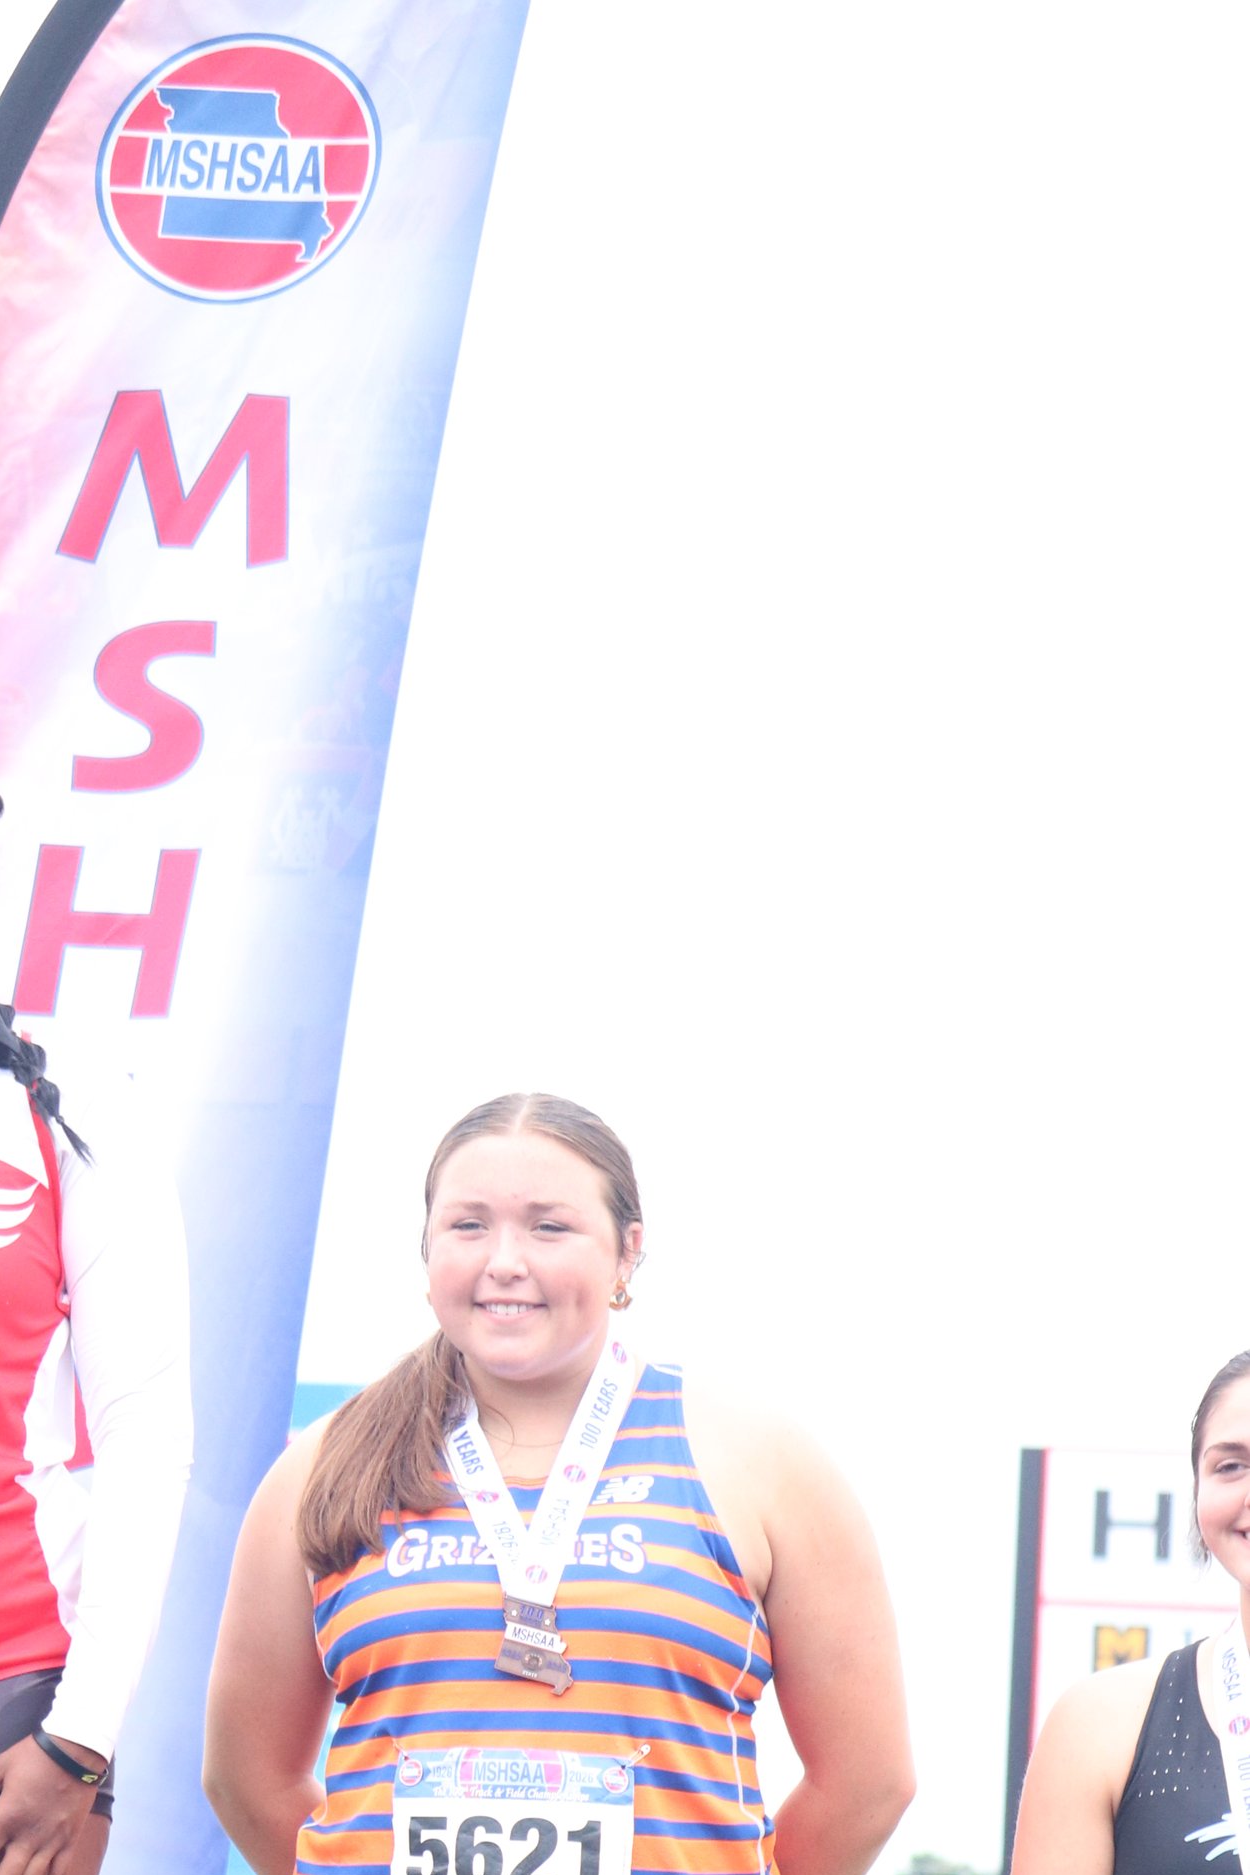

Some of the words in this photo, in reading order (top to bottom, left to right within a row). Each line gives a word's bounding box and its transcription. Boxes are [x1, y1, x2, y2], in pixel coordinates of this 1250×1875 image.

[145, 138, 321, 196] MSHSAA
[590, 1377, 620, 1424] YEARS
[579, 1421, 603, 1451] 100
[452, 1429, 485, 1477] YEARS
[511, 1625, 555, 1648] MSHSAA
[473, 1760, 545, 1783] MSHSAA
[470, 1786, 493, 1798] Track
[505, 1788, 526, 1799] Field
